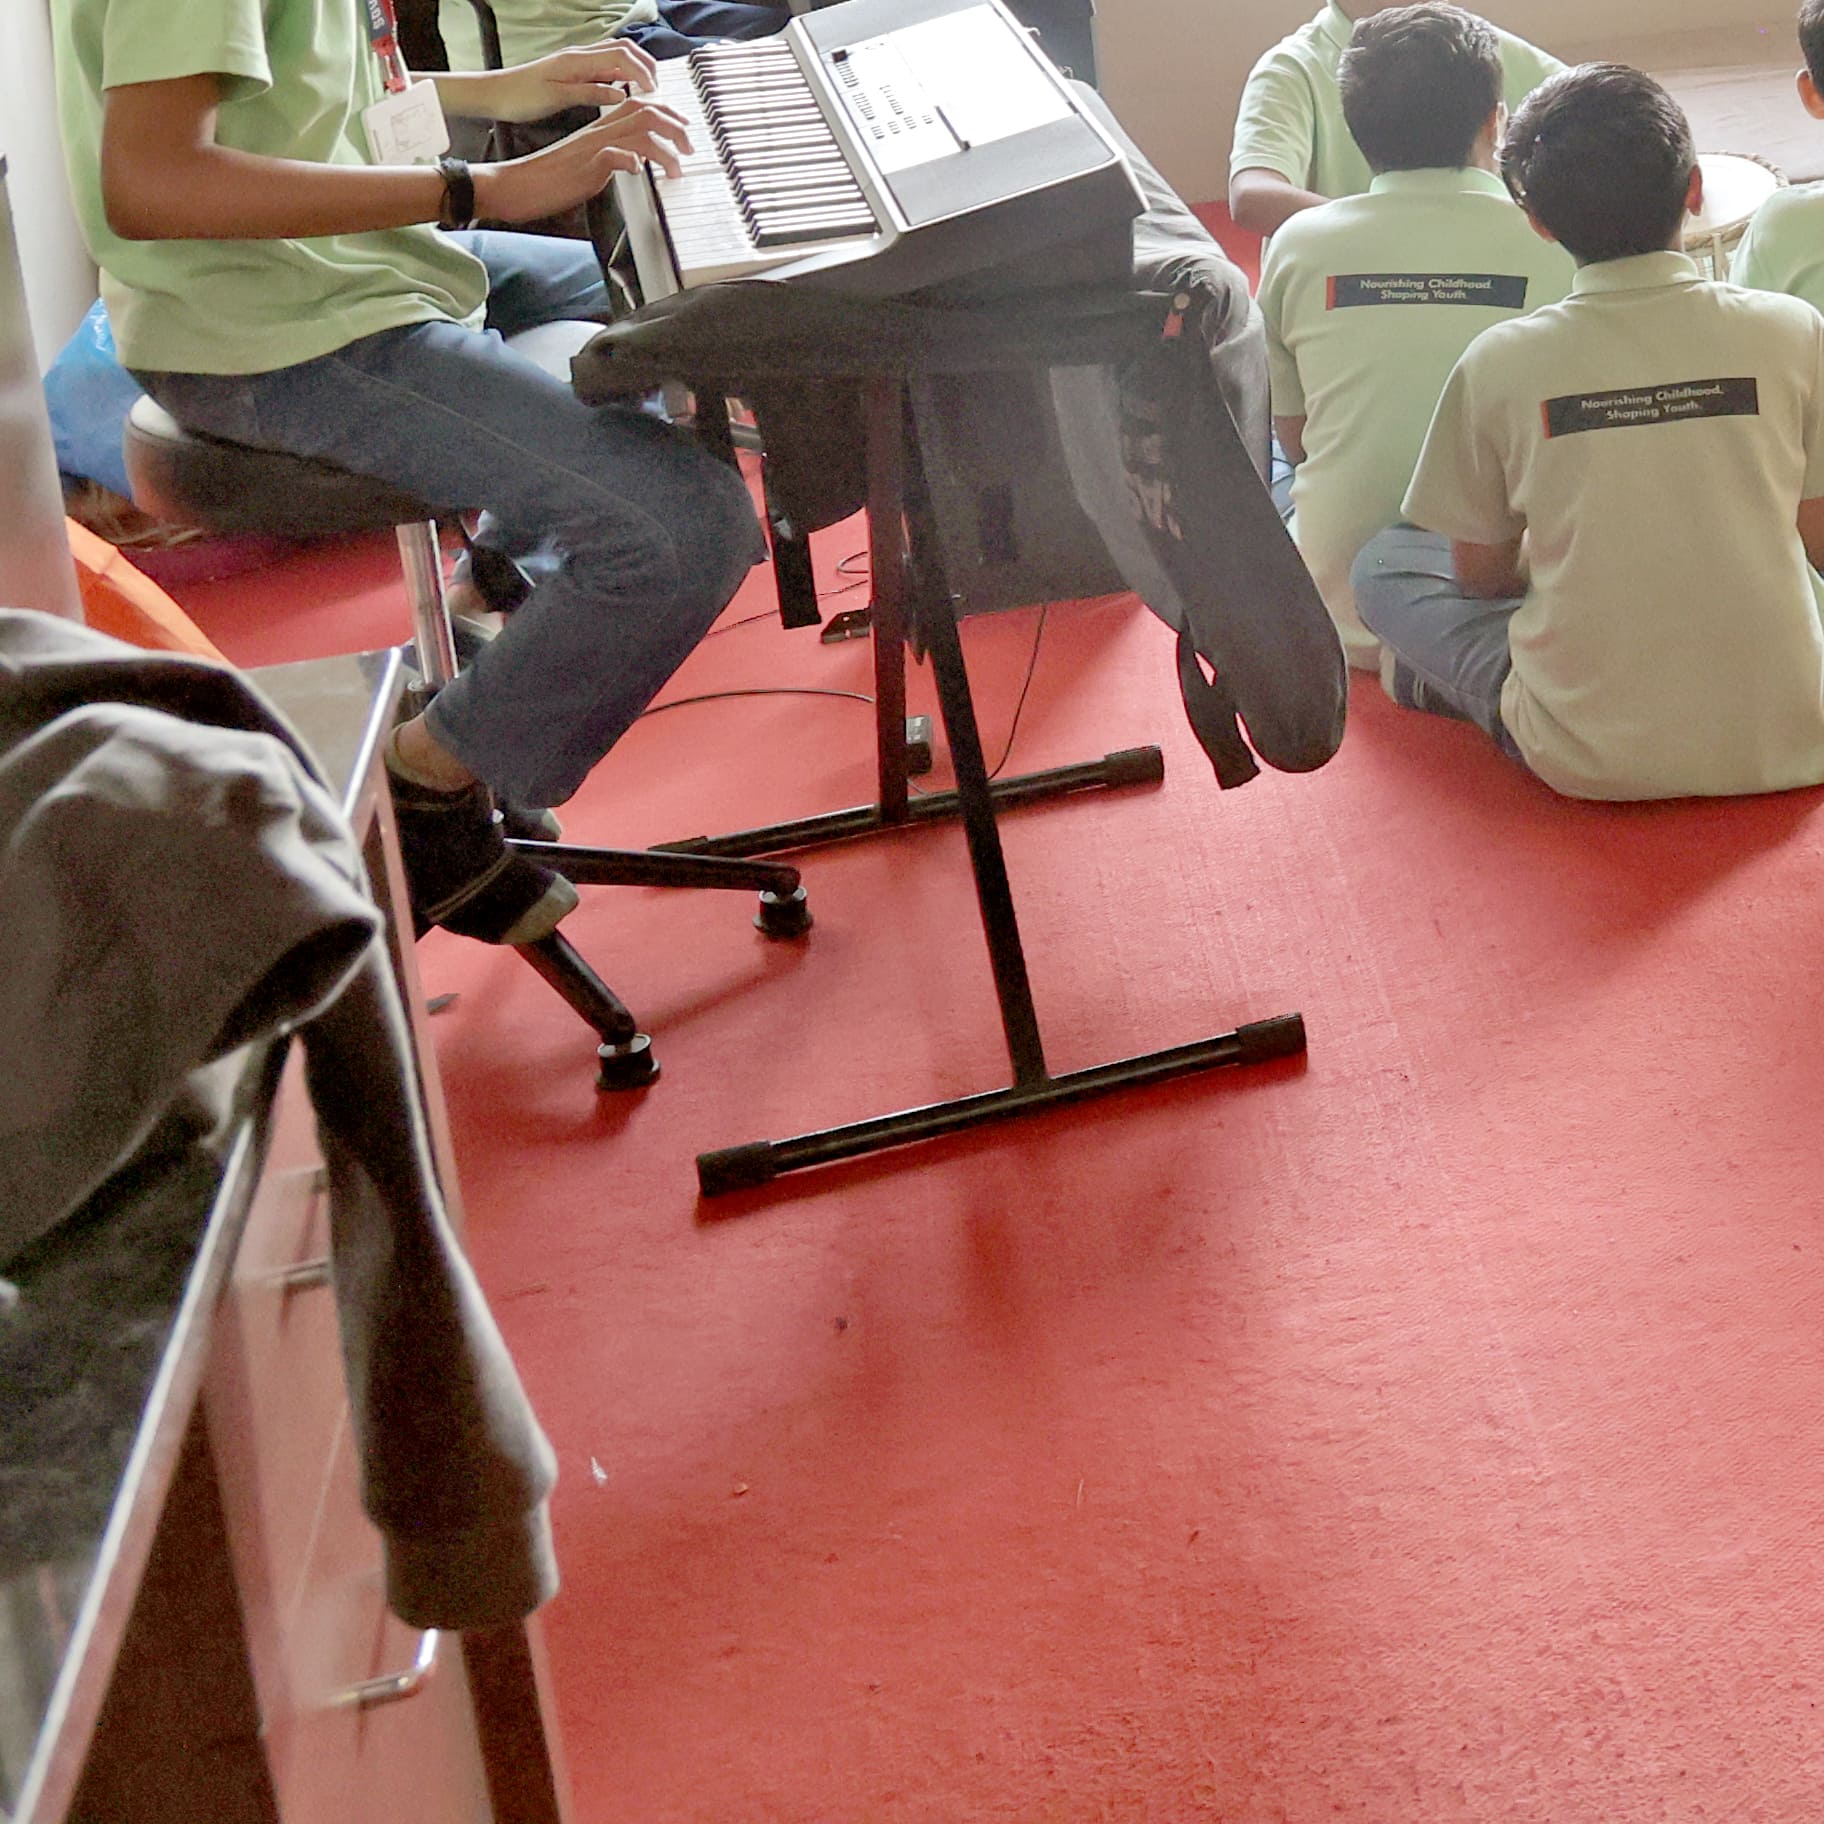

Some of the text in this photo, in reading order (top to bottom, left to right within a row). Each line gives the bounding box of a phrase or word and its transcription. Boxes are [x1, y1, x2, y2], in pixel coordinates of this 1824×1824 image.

[1360, 279, 1425, 291] Nourishing
[1380, 288, 1430, 301] Shaping
[1581, 392, 1653, 409] Nourishing
[1606, 407, 1661, 420] Shaping
